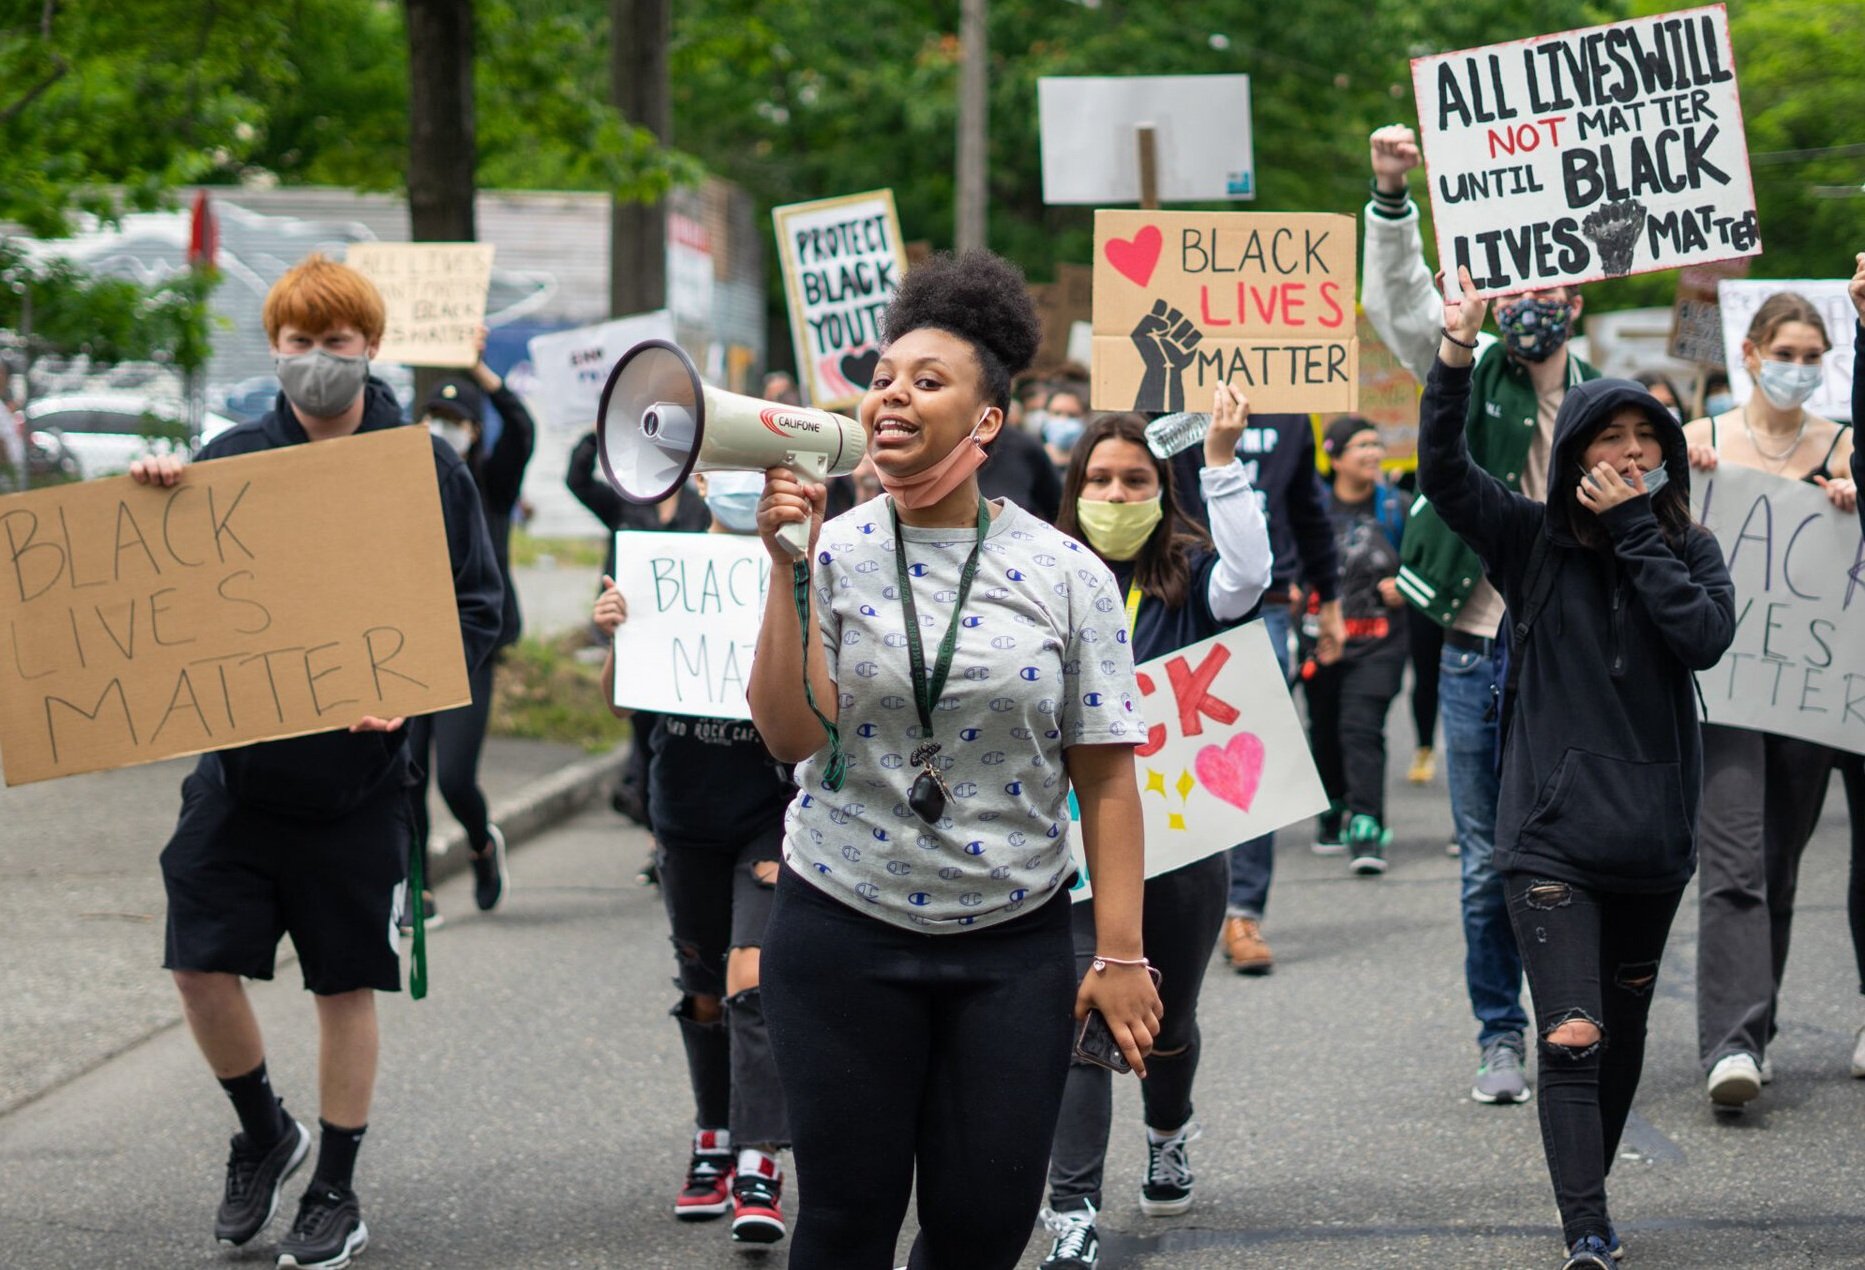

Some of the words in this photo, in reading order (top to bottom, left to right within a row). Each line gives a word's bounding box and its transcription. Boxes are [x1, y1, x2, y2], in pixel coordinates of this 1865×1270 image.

[1438, 54, 1518, 131] ALL
[1524, 28, 1639, 114] LIVES
[1625, 15, 1733, 95] WILL
[1487, 116, 1567, 159] NOT
[1577, 89, 1718, 141] MATTER
[1439, 164, 1544, 204] UNTIL
[1560, 123, 1731, 210] BLACK
[796, 215, 888, 266] PROTECT
[1181, 227, 1330, 275] BLACK
[1454, 217, 1591, 291] LIVES
[1647, 204, 1761, 260] MATTER
[802, 261, 896, 306] BLACK
[1200, 280, 1344, 328] LIVES
[808, 301, 886, 354] YOUT
[1198, 343, 1349, 387] MATTER
[778, 416, 821, 433] CALIFONE
[0, 480, 255, 602] BLACK
[10, 569, 271, 679] LIVES
[45, 625, 429, 764] MATTER
[1722, 651, 1865, 724] TTER
